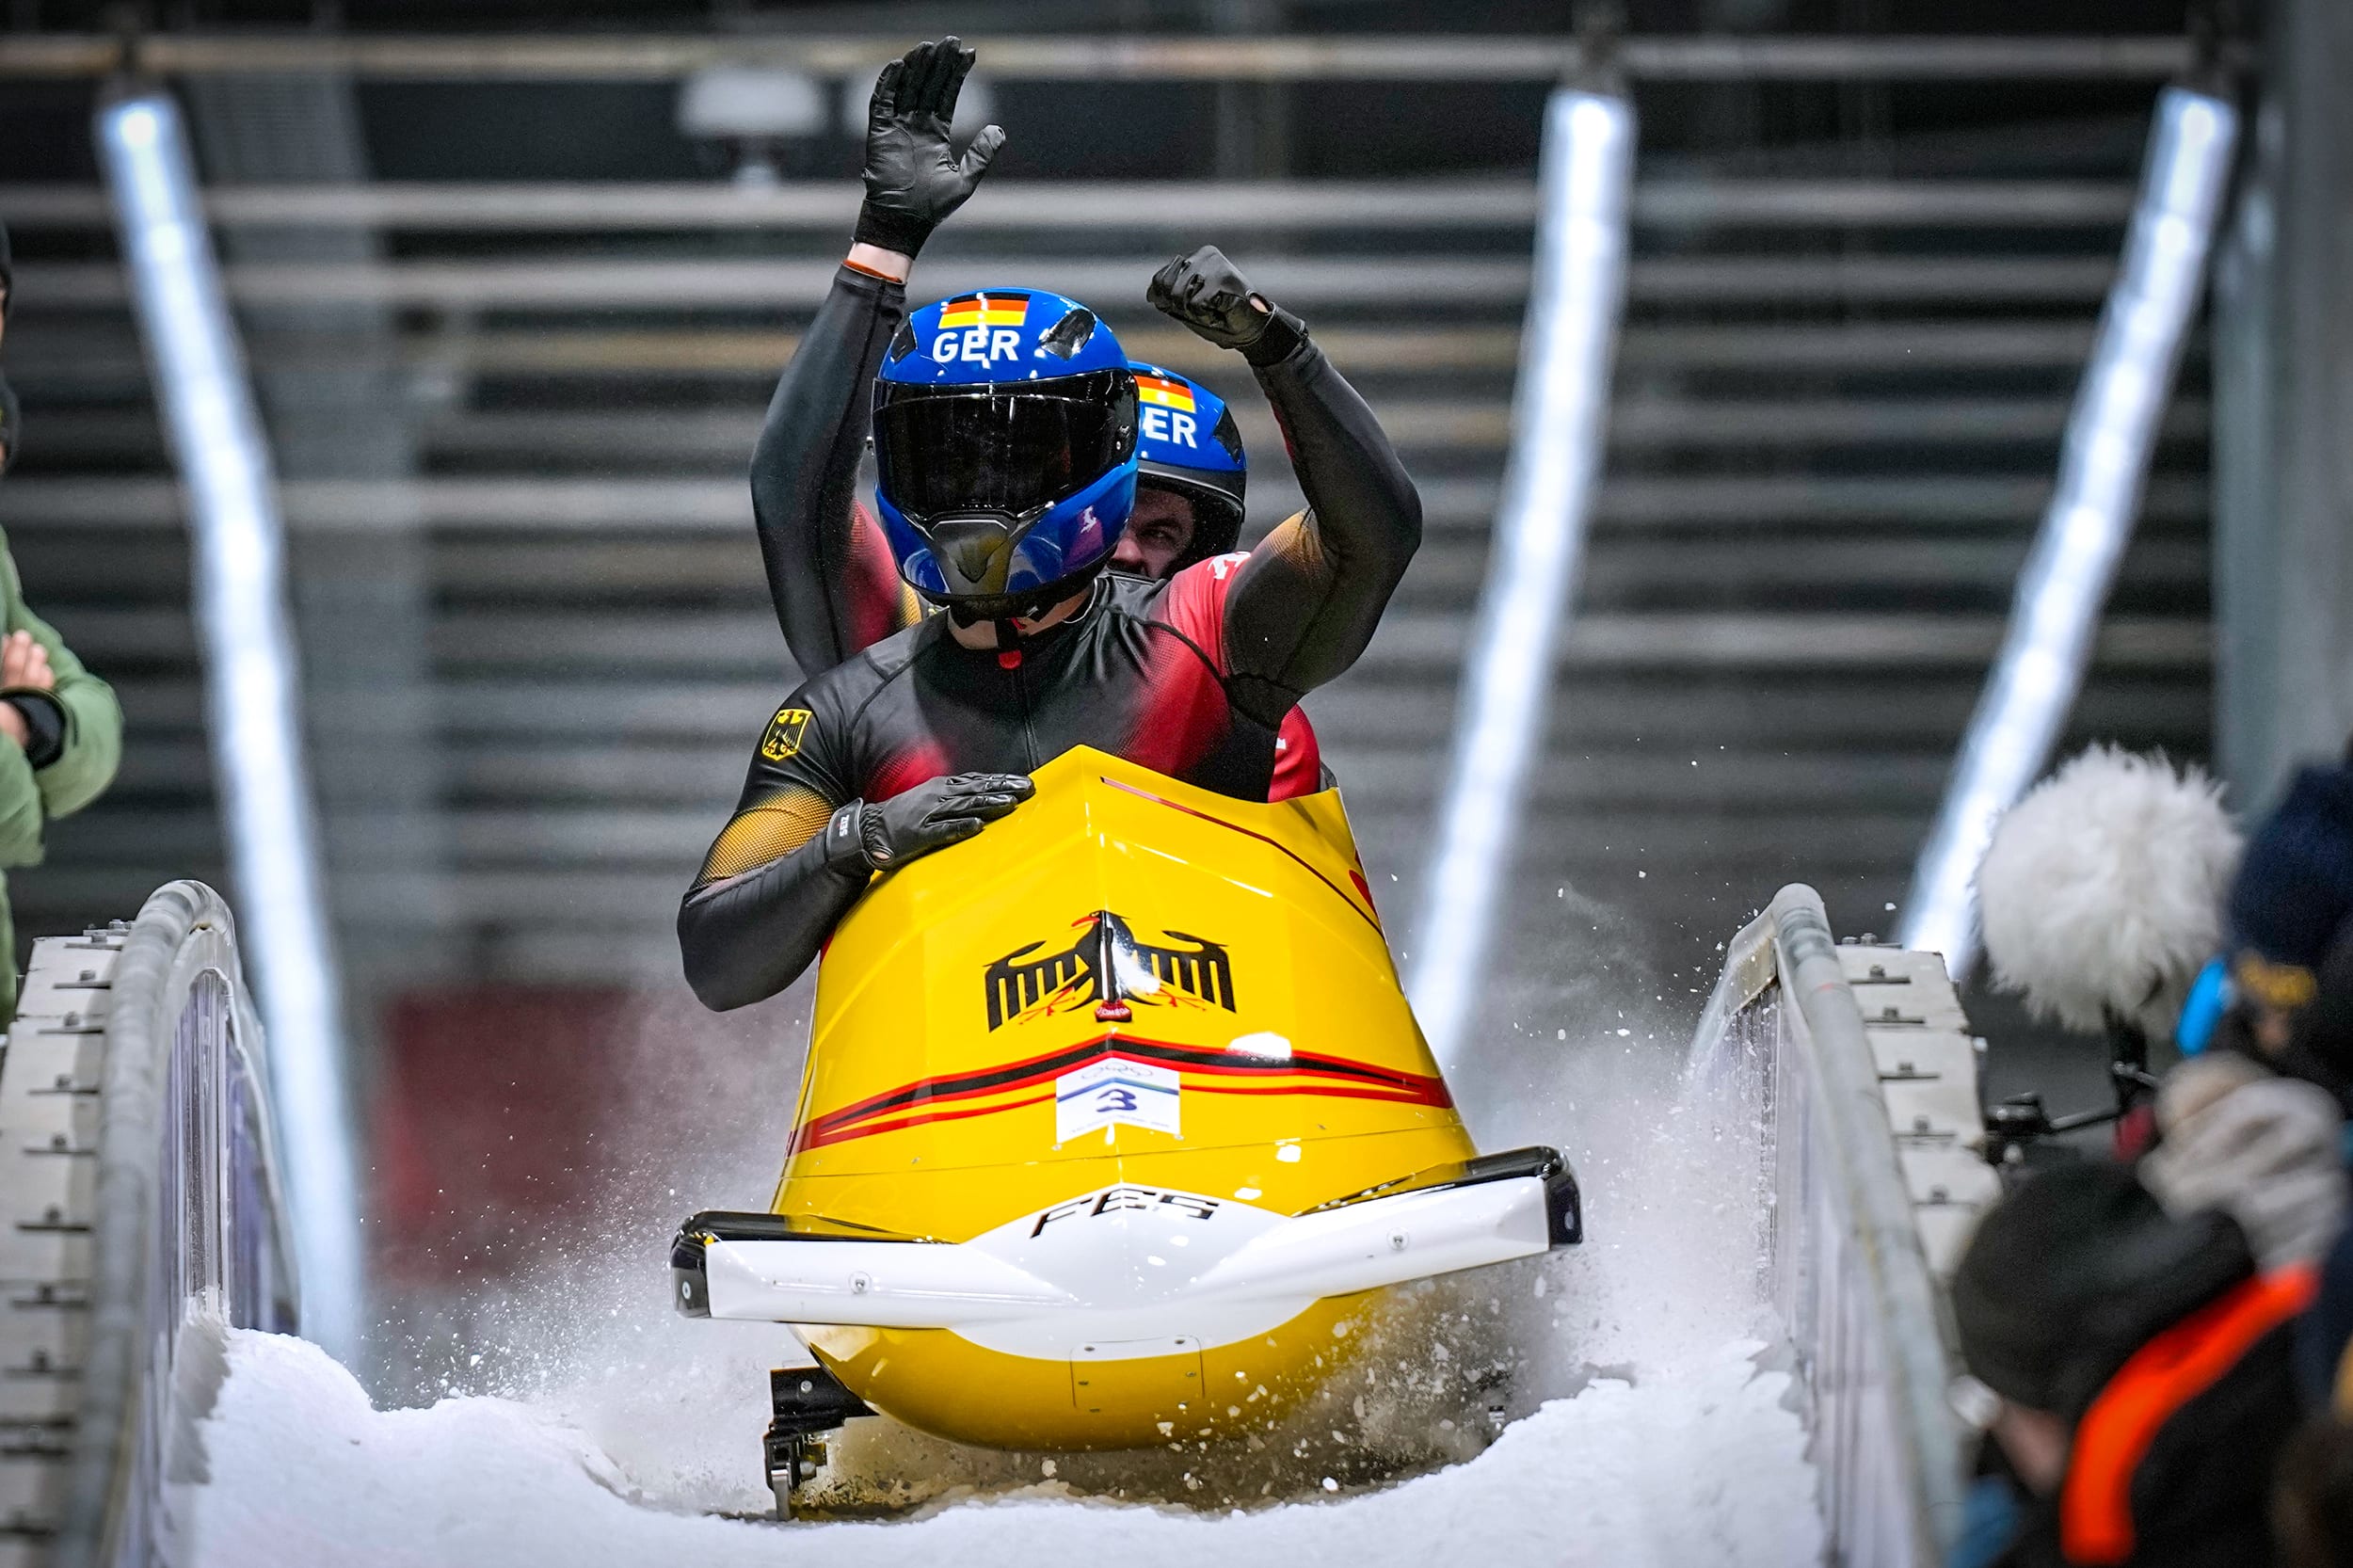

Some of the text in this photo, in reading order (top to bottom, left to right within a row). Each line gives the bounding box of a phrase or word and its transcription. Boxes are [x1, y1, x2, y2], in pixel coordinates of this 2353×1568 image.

[932, 329, 1021, 363] GER
[1143, 407, 1197, 449] ER
[1096, 1088, 1137, 1112] 3
[1030, 1188, 1219, 1239] FES
